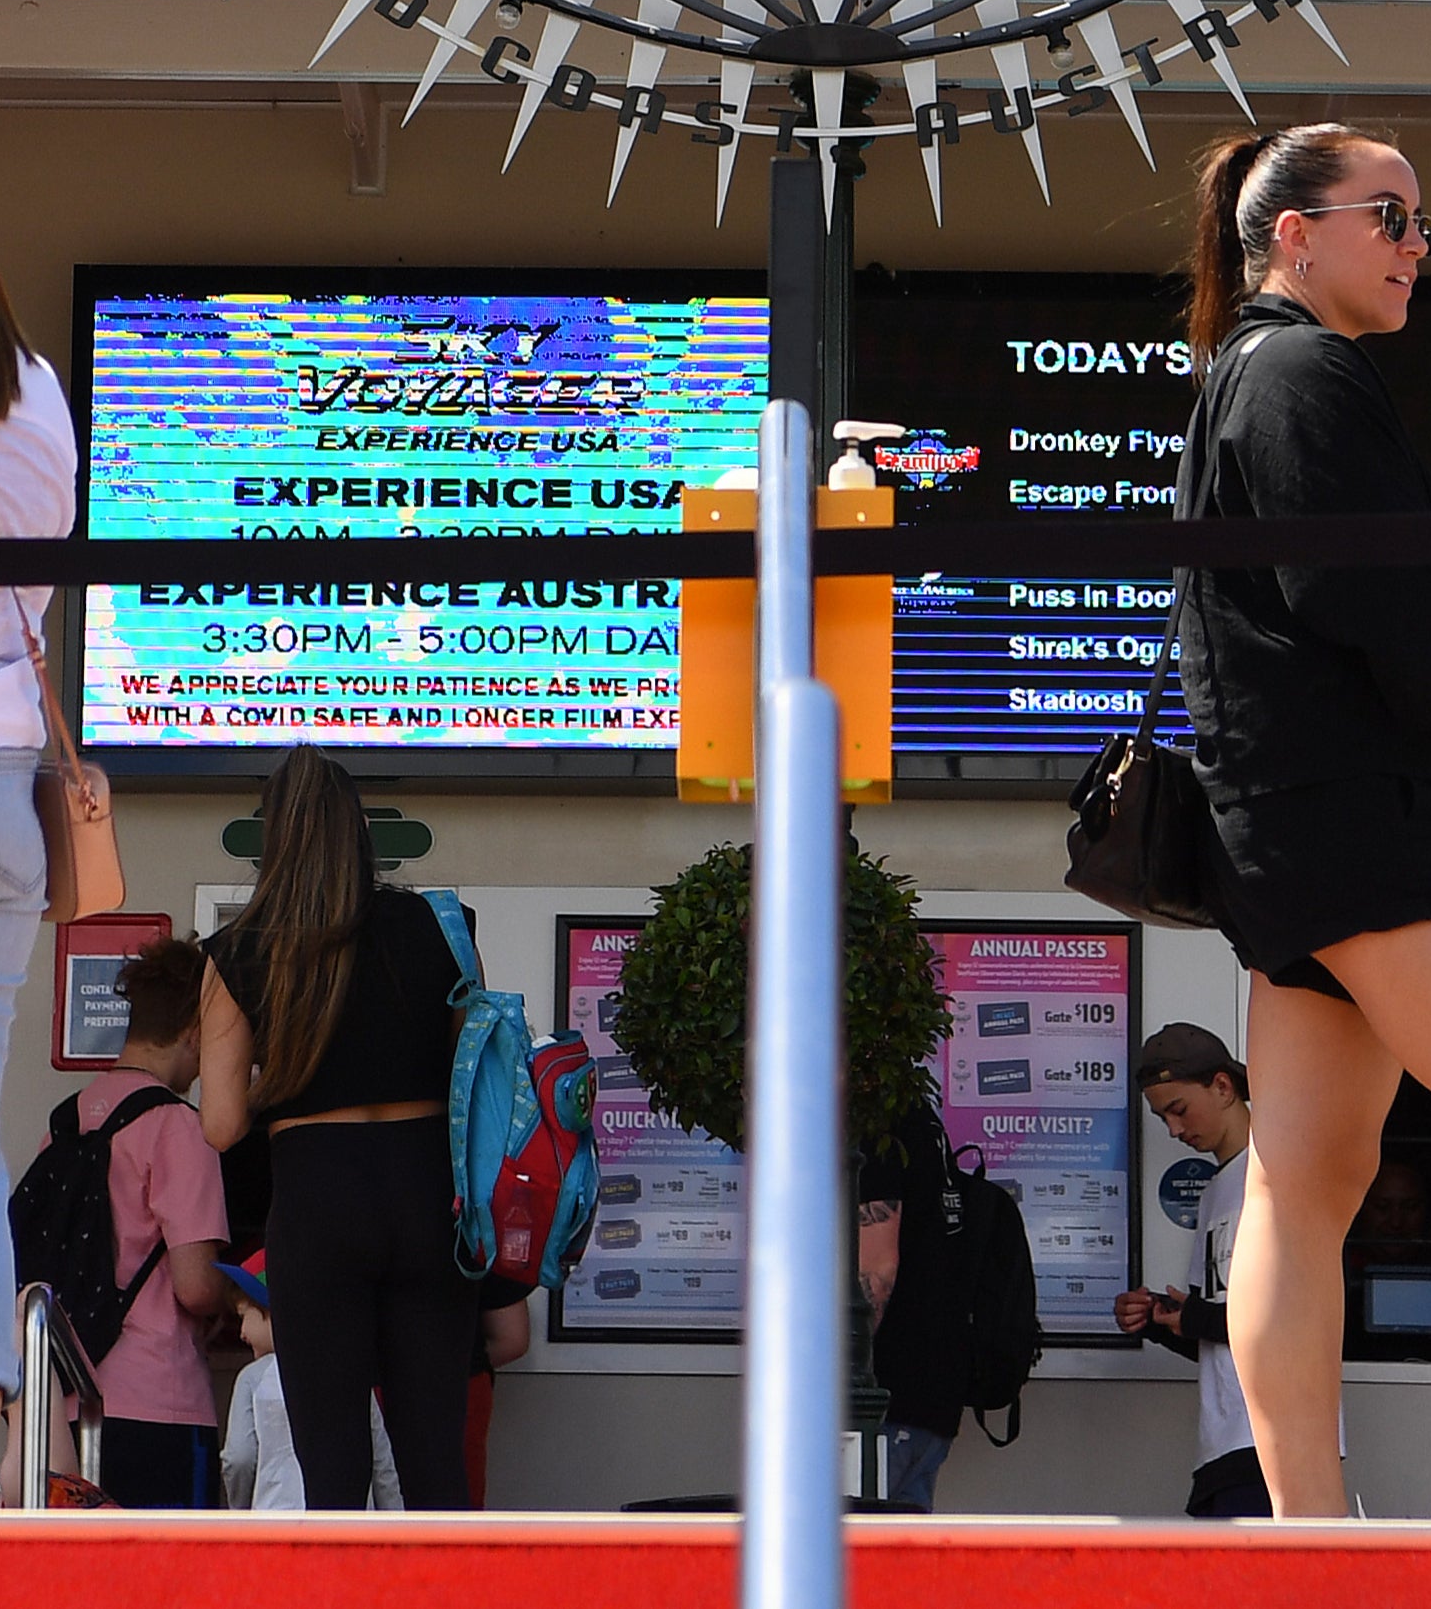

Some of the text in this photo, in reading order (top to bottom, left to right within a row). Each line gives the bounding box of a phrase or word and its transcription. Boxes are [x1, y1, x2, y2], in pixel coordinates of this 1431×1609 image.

[480, 35, 810, 155] COAST
[1007, 339, 1192, 376] TODAY'S
[314, 429, 621, 454] EXPERIENCE USA
[1009, 428, 1121, 459] Dronkey
[1128, 429, 1187, 460] Flye
[231, 477, 574, 509] EXPERIENCE
[1009, 479, 1107, 509] Escape
[139, 578, 680, 609] EXPERIENCE AUSTR
[1008, 583, 1076, 609] Puss
[1083, 584, 1108, 609] In
[201, 623, 372, 654] 3:30PM
[418, 624, 588, 656] 5:00PM
[1008, 634, 1110, 661] Shrek's
[120, 674, 161, 695] WE
[167, 674, 330, 696] APPRECIATE
[335, 675, 409, 696] YOUR
[416, 675, 540, 697] PATIENCE
[545, 676, 581, 698] AS
[588, 676, 629, 698] WE
[1008, 687, 1144, 713] Skadoosh
[125, 706, 191, 727] WITH
[198, 707, 217, 727] A
[225, 706, 307, 727] COVID
[313, 707, 379, 728] SAFE
[385, 707, 442, 729] AND
[451, 707, 555, 729] LONGER
[564, 708, 623, 730] FILM
[970, 940, 1108, 959] ANNUAL PASSES
[1044, 1003, 1116, 1024] Gate $109
[1044, 1061, 1116, 1082] Gate $189
[601, 1110, 657, 1131] QUICK
[982, 1115, 1094, 1138] QUICK VISIT?
